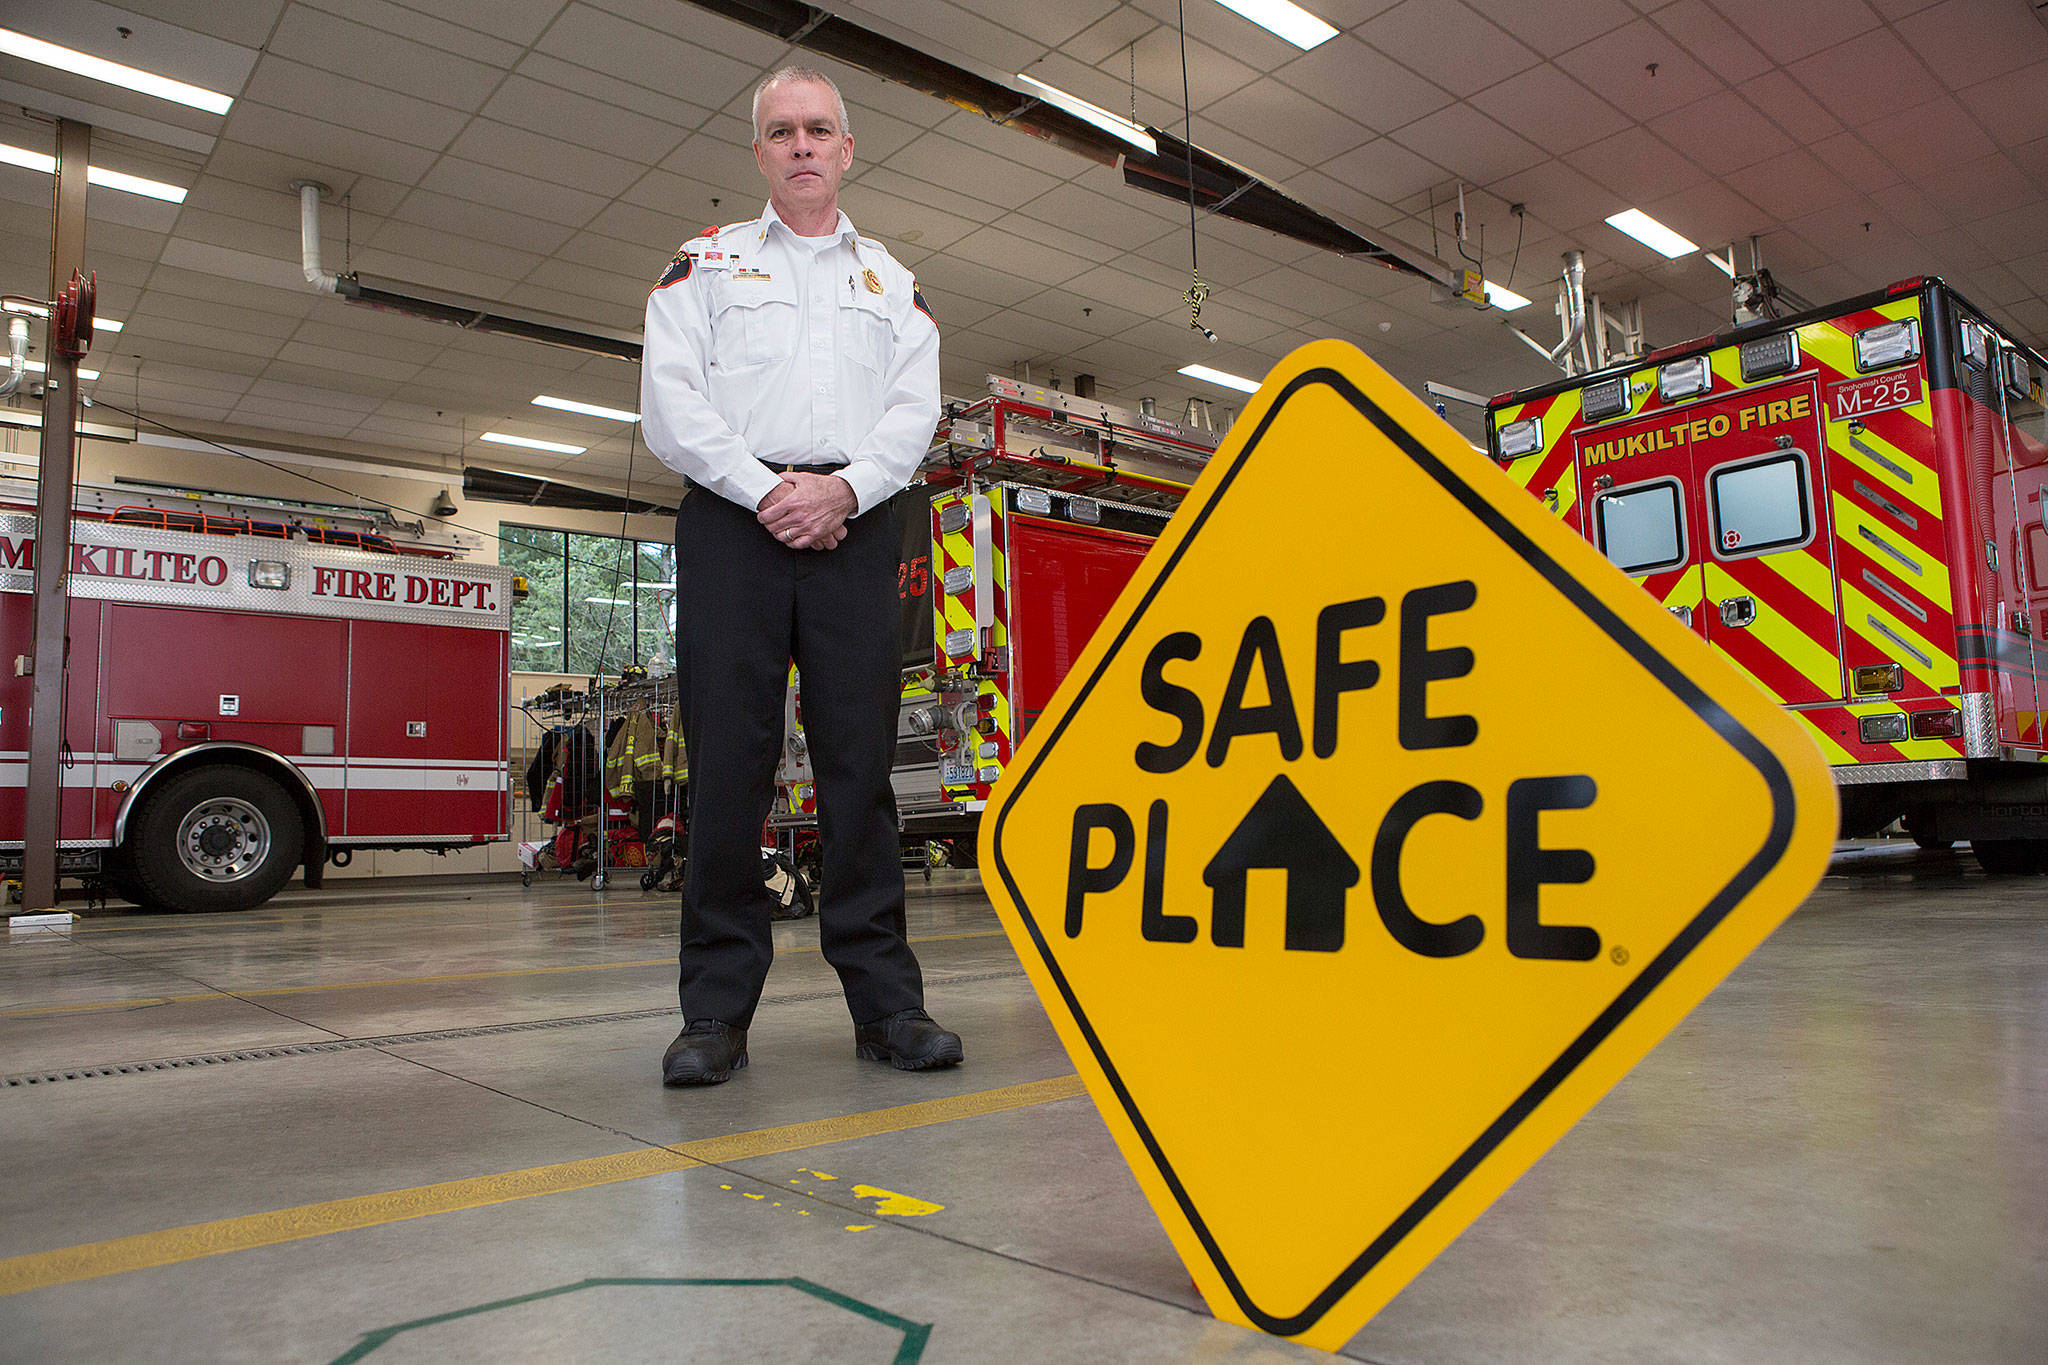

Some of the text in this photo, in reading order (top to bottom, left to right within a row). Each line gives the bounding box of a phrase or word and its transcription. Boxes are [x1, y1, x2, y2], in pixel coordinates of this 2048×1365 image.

[1837, 379, 1910, 415] M-25
[1838, 372, 1907, 392] Snohomish County
[1584, 393, 1812, 467] MUKILTEO FIRE
[0, 536, 496, 611] MKILTEO FIRE DEPT.
[1134, 579, 1478, 774] SAFE
